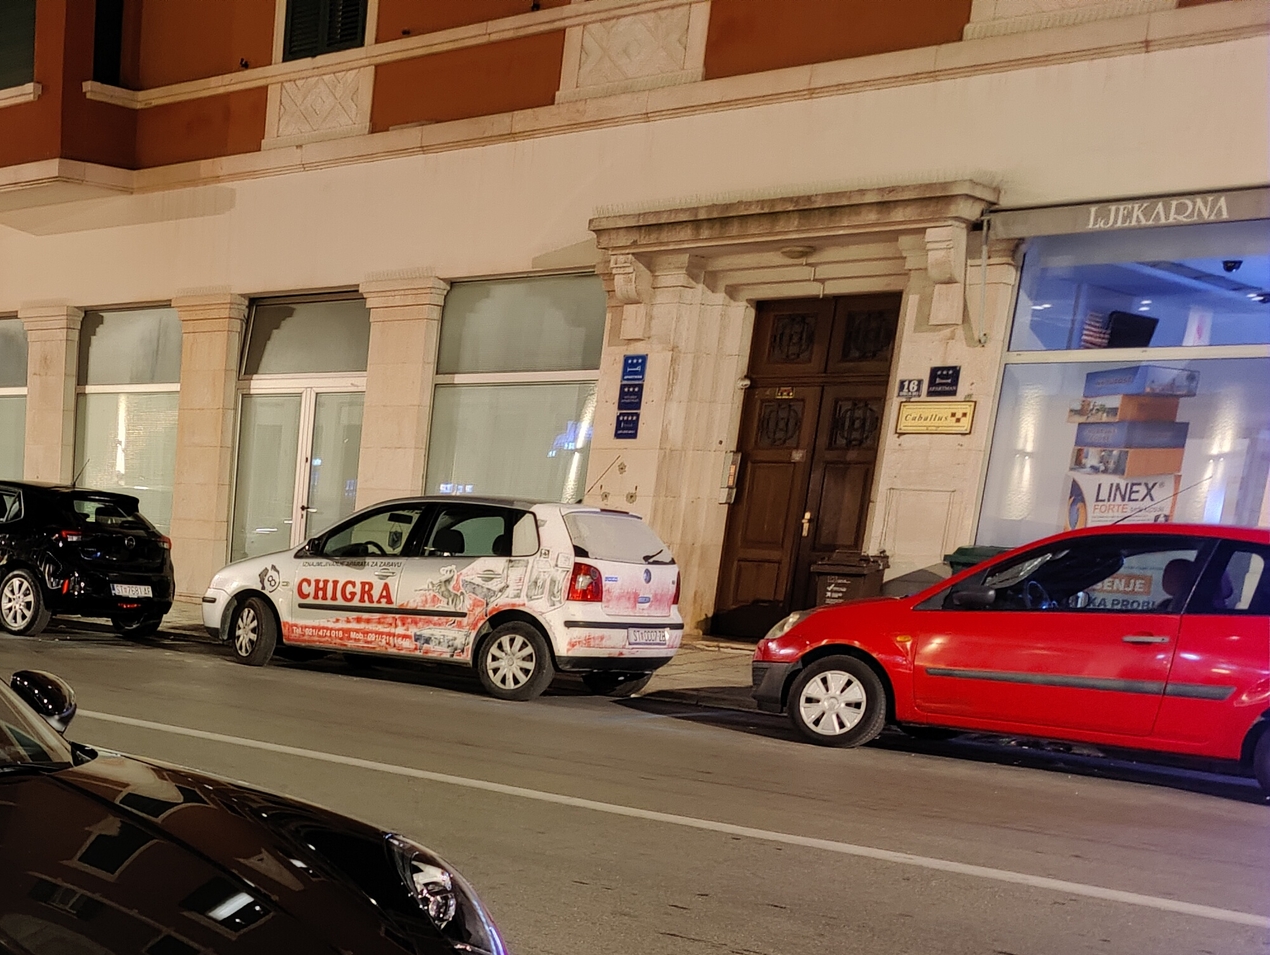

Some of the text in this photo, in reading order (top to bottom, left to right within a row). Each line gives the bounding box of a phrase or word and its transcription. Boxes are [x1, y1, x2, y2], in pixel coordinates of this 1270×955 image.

[1087, 195, 1230, 230] LJEKARNA
[902, 380, 918, 392] 16
[904, 412, 949, 422] Caballus
[1095, 481, 1159, 502] LINEX
[1093, 504, 1128, 513] FORTE
[297, 577, 394, 605] CHIGRA
